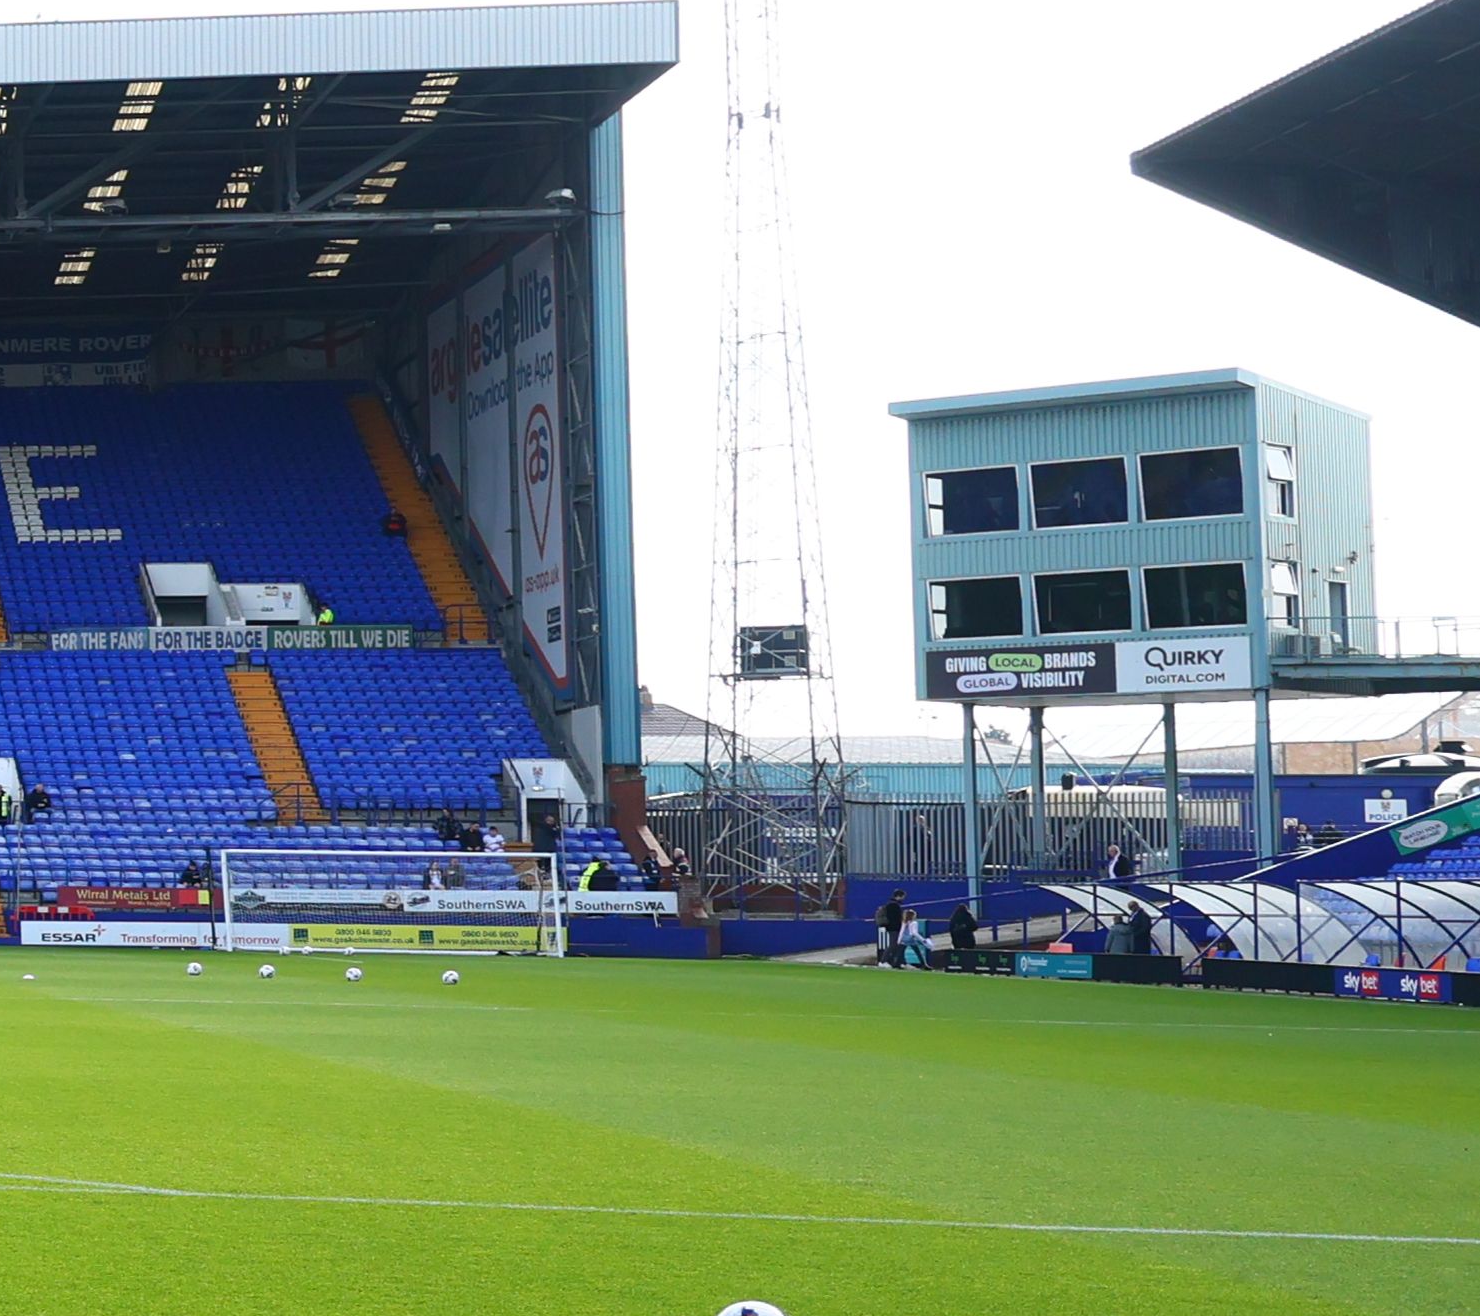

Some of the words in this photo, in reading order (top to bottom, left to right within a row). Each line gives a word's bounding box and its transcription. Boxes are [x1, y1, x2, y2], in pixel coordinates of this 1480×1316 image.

[52, 633, 78, 651] FOR
[81, 633, 107, 651] THE
[110, 632, 144, 650] FANS
[155, 632, 183, 650] FOR
[185, 631, 212, 649] THE
[215, 630, 263, 649] BADGE
[274, 630, 327, 649] ROVERS
[329, 629, 358, 648] TILL
[361, 629, 383, 648] WE
[386, 629, 411, 647] DIE
[945, 656, 987, 673] GIVING
[995, 656, 1036, 669] LOCAL
[1044, 651, 1096, 669] BRANDS
[1144, 646, 1224, 671] QUIRKY
[963, 677, 1013, 689] GLOBAL
[1020, 670, 1085, 689] VISIBILITY
[1145, 672, 1225, 685] DIGITAL.COM
[1369, 813, 1403, 821] POLICE
[76, 889, 109, 900] Wirral
[112, 889, 149, 901] Metals
[153, 890, 171, 901] Ltd
[437, 899, 526, 910] SouthernSWA
[575, 900, 666, 912] SouthernSWA
[41, 933, 96, 943] ESSAR
[121, 934, 197, 946] Transforming
[1344, 971, 1360, 992] sky
[1361, 972, 1379, 990] bet
[1400, 974, 1418, 996] sky
[1419, 976, 1438, 994] bet
